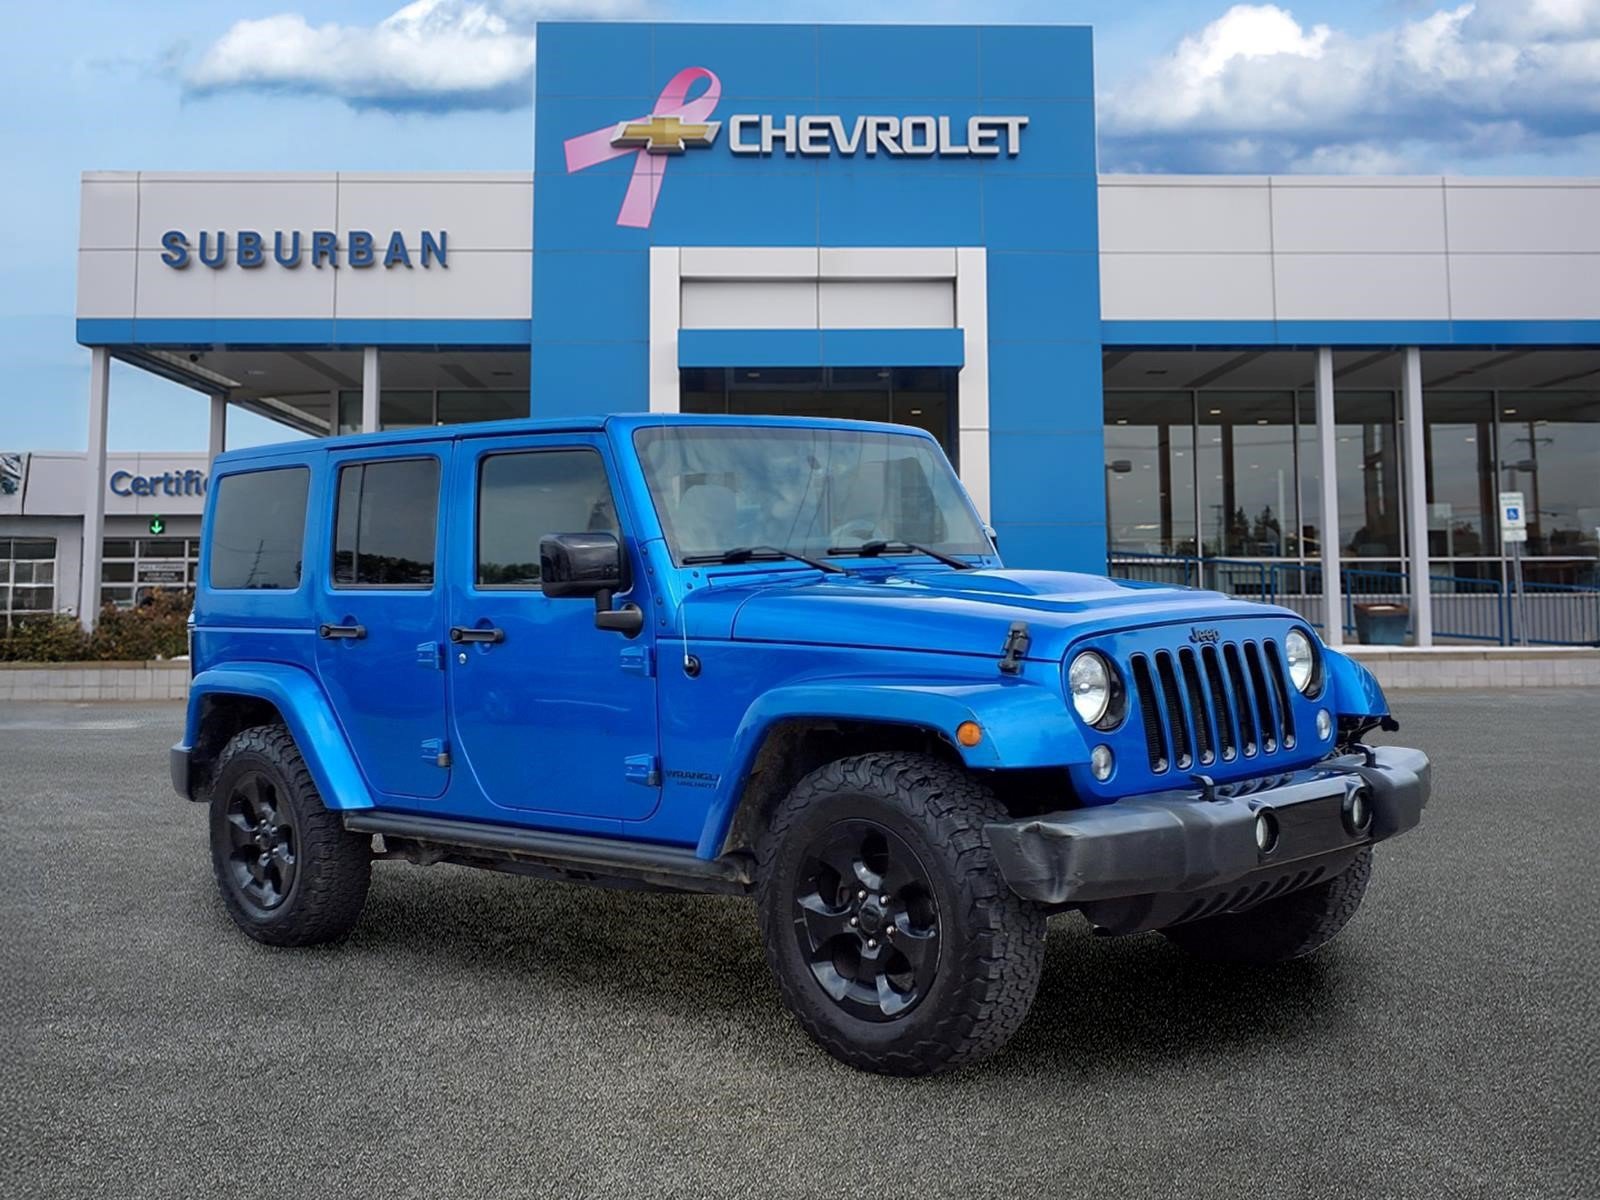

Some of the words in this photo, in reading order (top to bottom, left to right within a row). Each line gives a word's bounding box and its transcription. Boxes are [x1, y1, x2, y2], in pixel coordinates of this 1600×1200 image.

[728, 114, 1029, 156] CHEVROLET
[160, 230, 449, 270] SUBURBAN
[1188, 627, 1220, 644] Jeep
